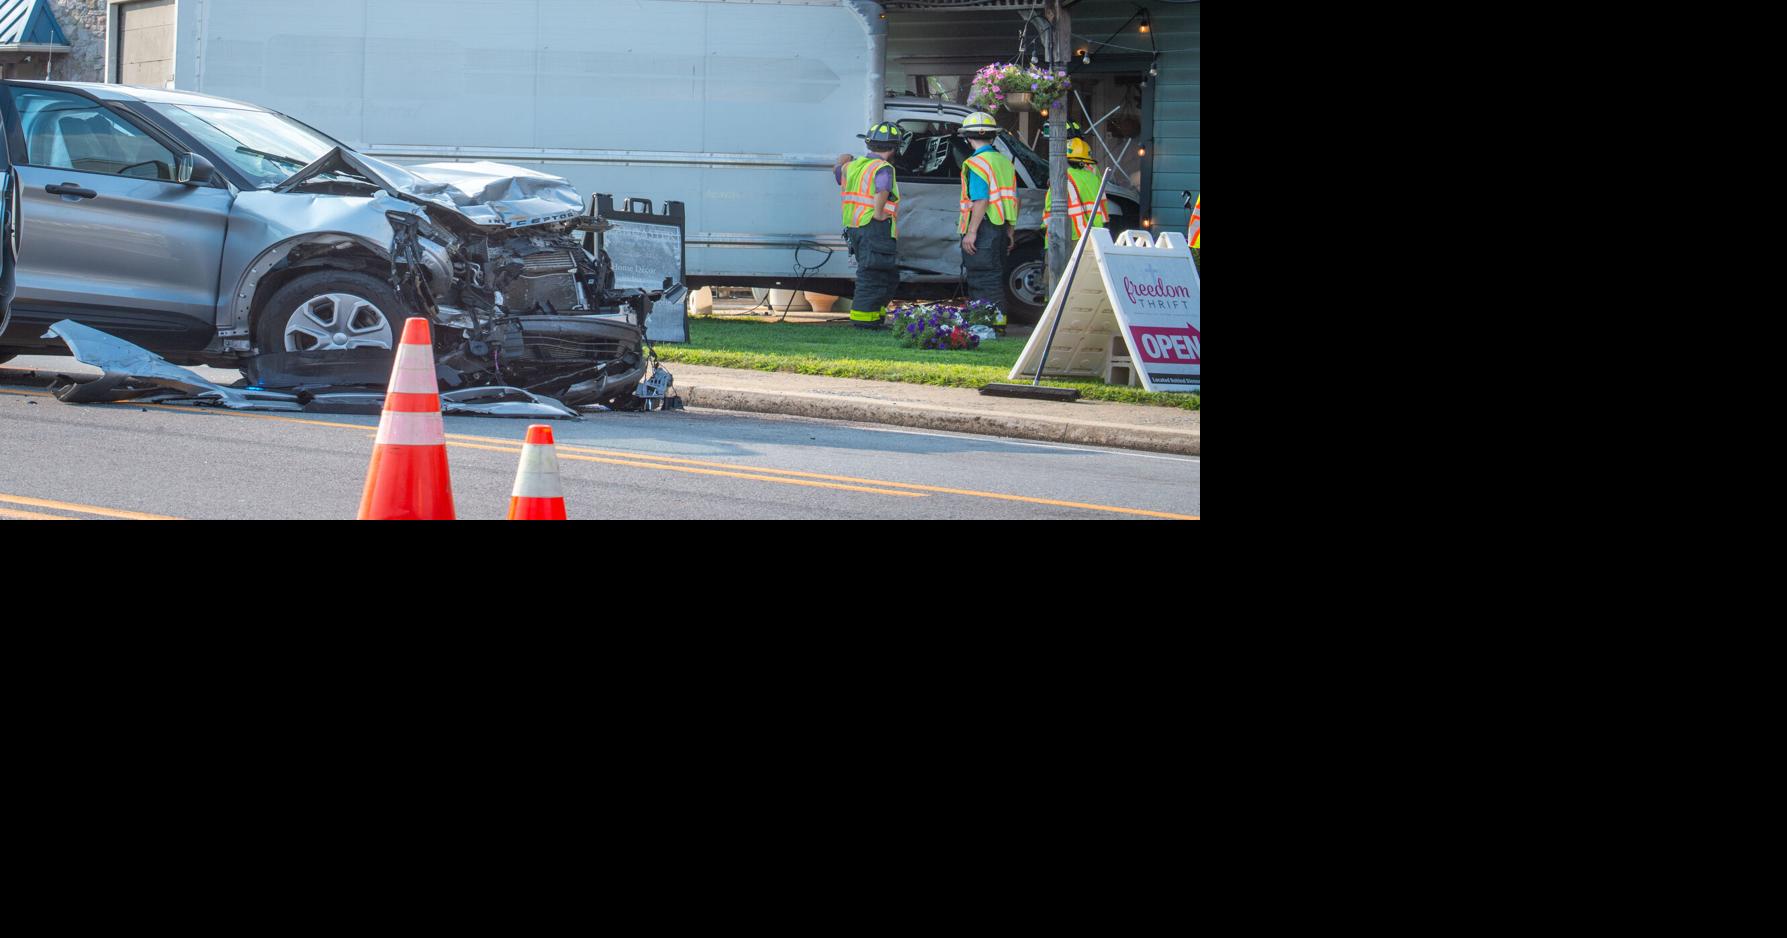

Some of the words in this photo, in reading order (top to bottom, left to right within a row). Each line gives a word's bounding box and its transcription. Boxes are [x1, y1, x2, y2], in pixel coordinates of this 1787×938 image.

[1123, 276, 1190, 304] freedom
[1138, 299, 1188, 310] THRIFT
[1141, 333, 1200, 360] OPEN
